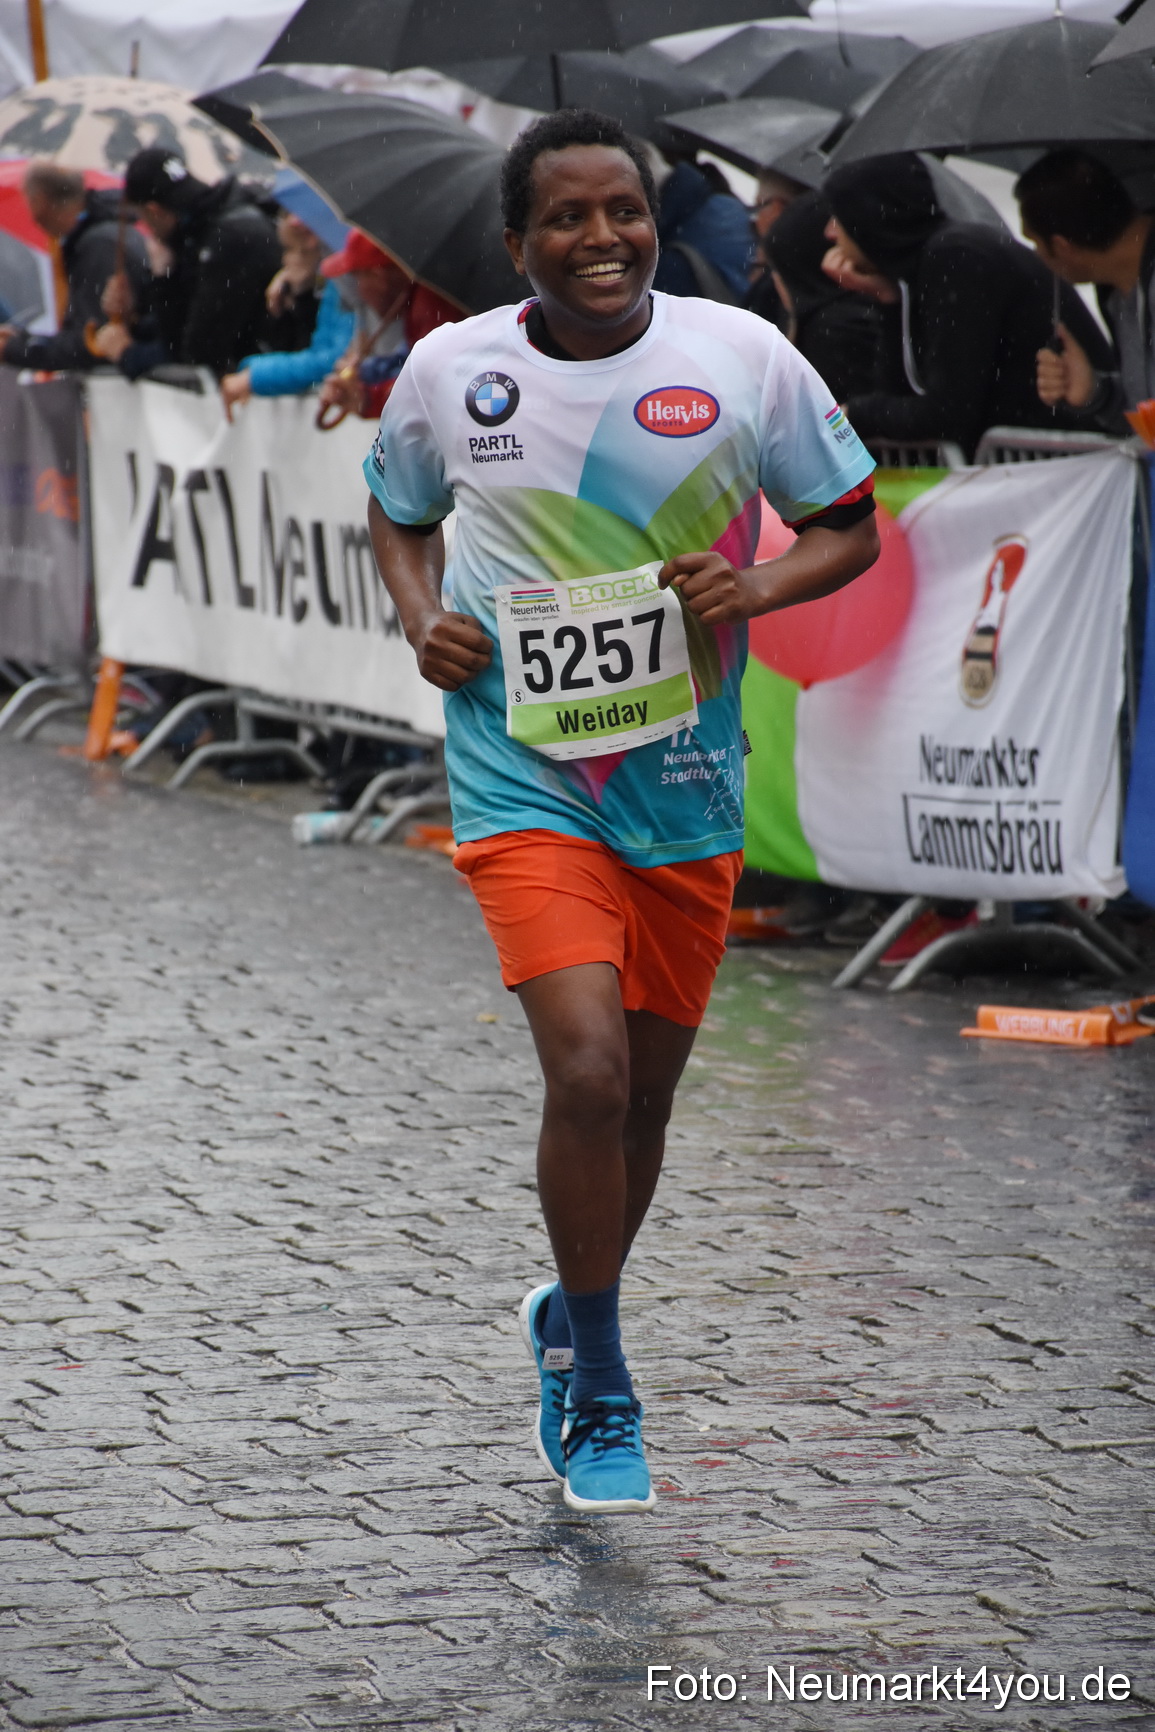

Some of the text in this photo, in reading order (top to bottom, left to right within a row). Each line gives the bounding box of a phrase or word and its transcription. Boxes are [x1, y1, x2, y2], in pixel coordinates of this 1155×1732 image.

[470, 373, 515, 391] BMW
[647, 400, 710, 424] Hervis
[468, 434, 523, 452] PARTL
[471, 450, 524, 464] Neumarkt
[568, 573, 658, 607] BOCK
[611, 600, 632, 608] smart
[634, 592, 662, 604] concepts
[510, 603, 560, 616] NeuerMarkt
[519, 607, 665, 694] 5257
[515, 691, 522, 703] S
[556, 701, 648, 735] Weiday
[920, 734, 1039, 787] Neumarkter
[902, 793, 1063, 876] Lammsbräu
